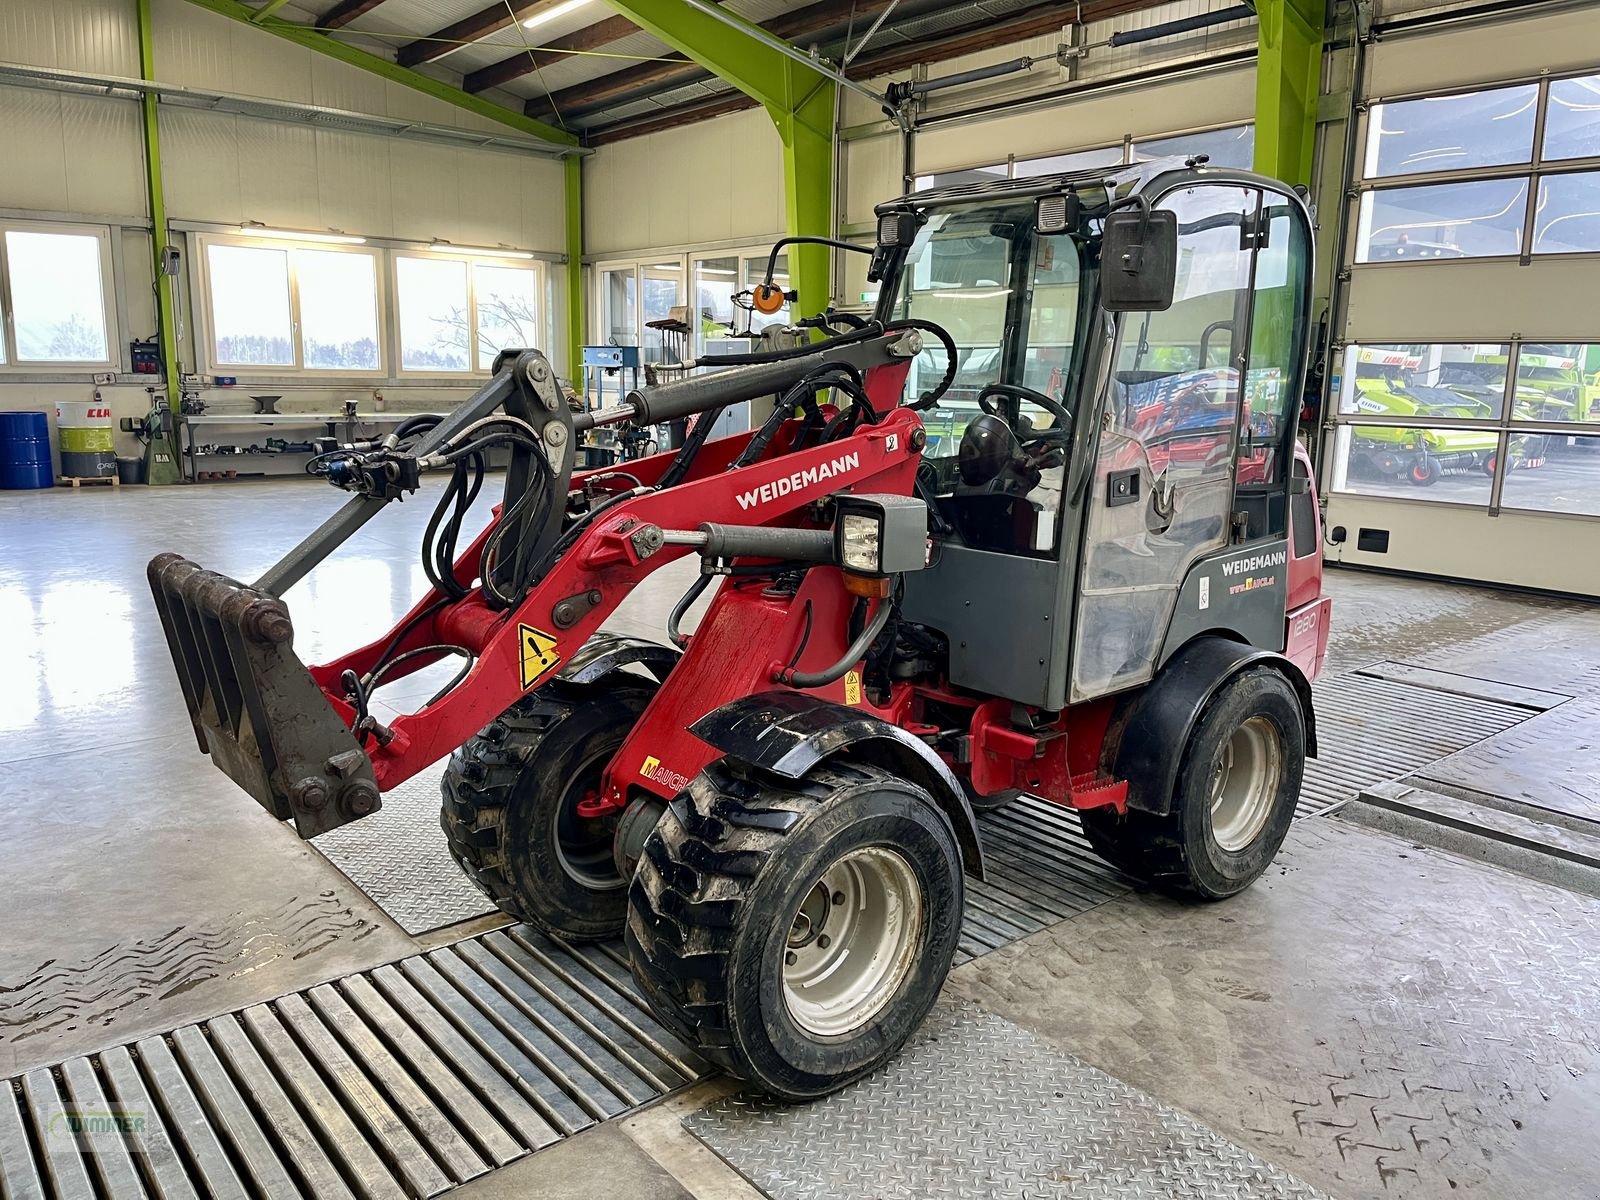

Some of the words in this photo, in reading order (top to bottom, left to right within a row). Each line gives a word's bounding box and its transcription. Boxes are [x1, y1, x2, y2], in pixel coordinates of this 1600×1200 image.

[735, 451, 860, 510] WEIDEMANN
[1222, 551, 1286, 576] WEIDEMANN
[642, 762, 689, 792] MAUCH
